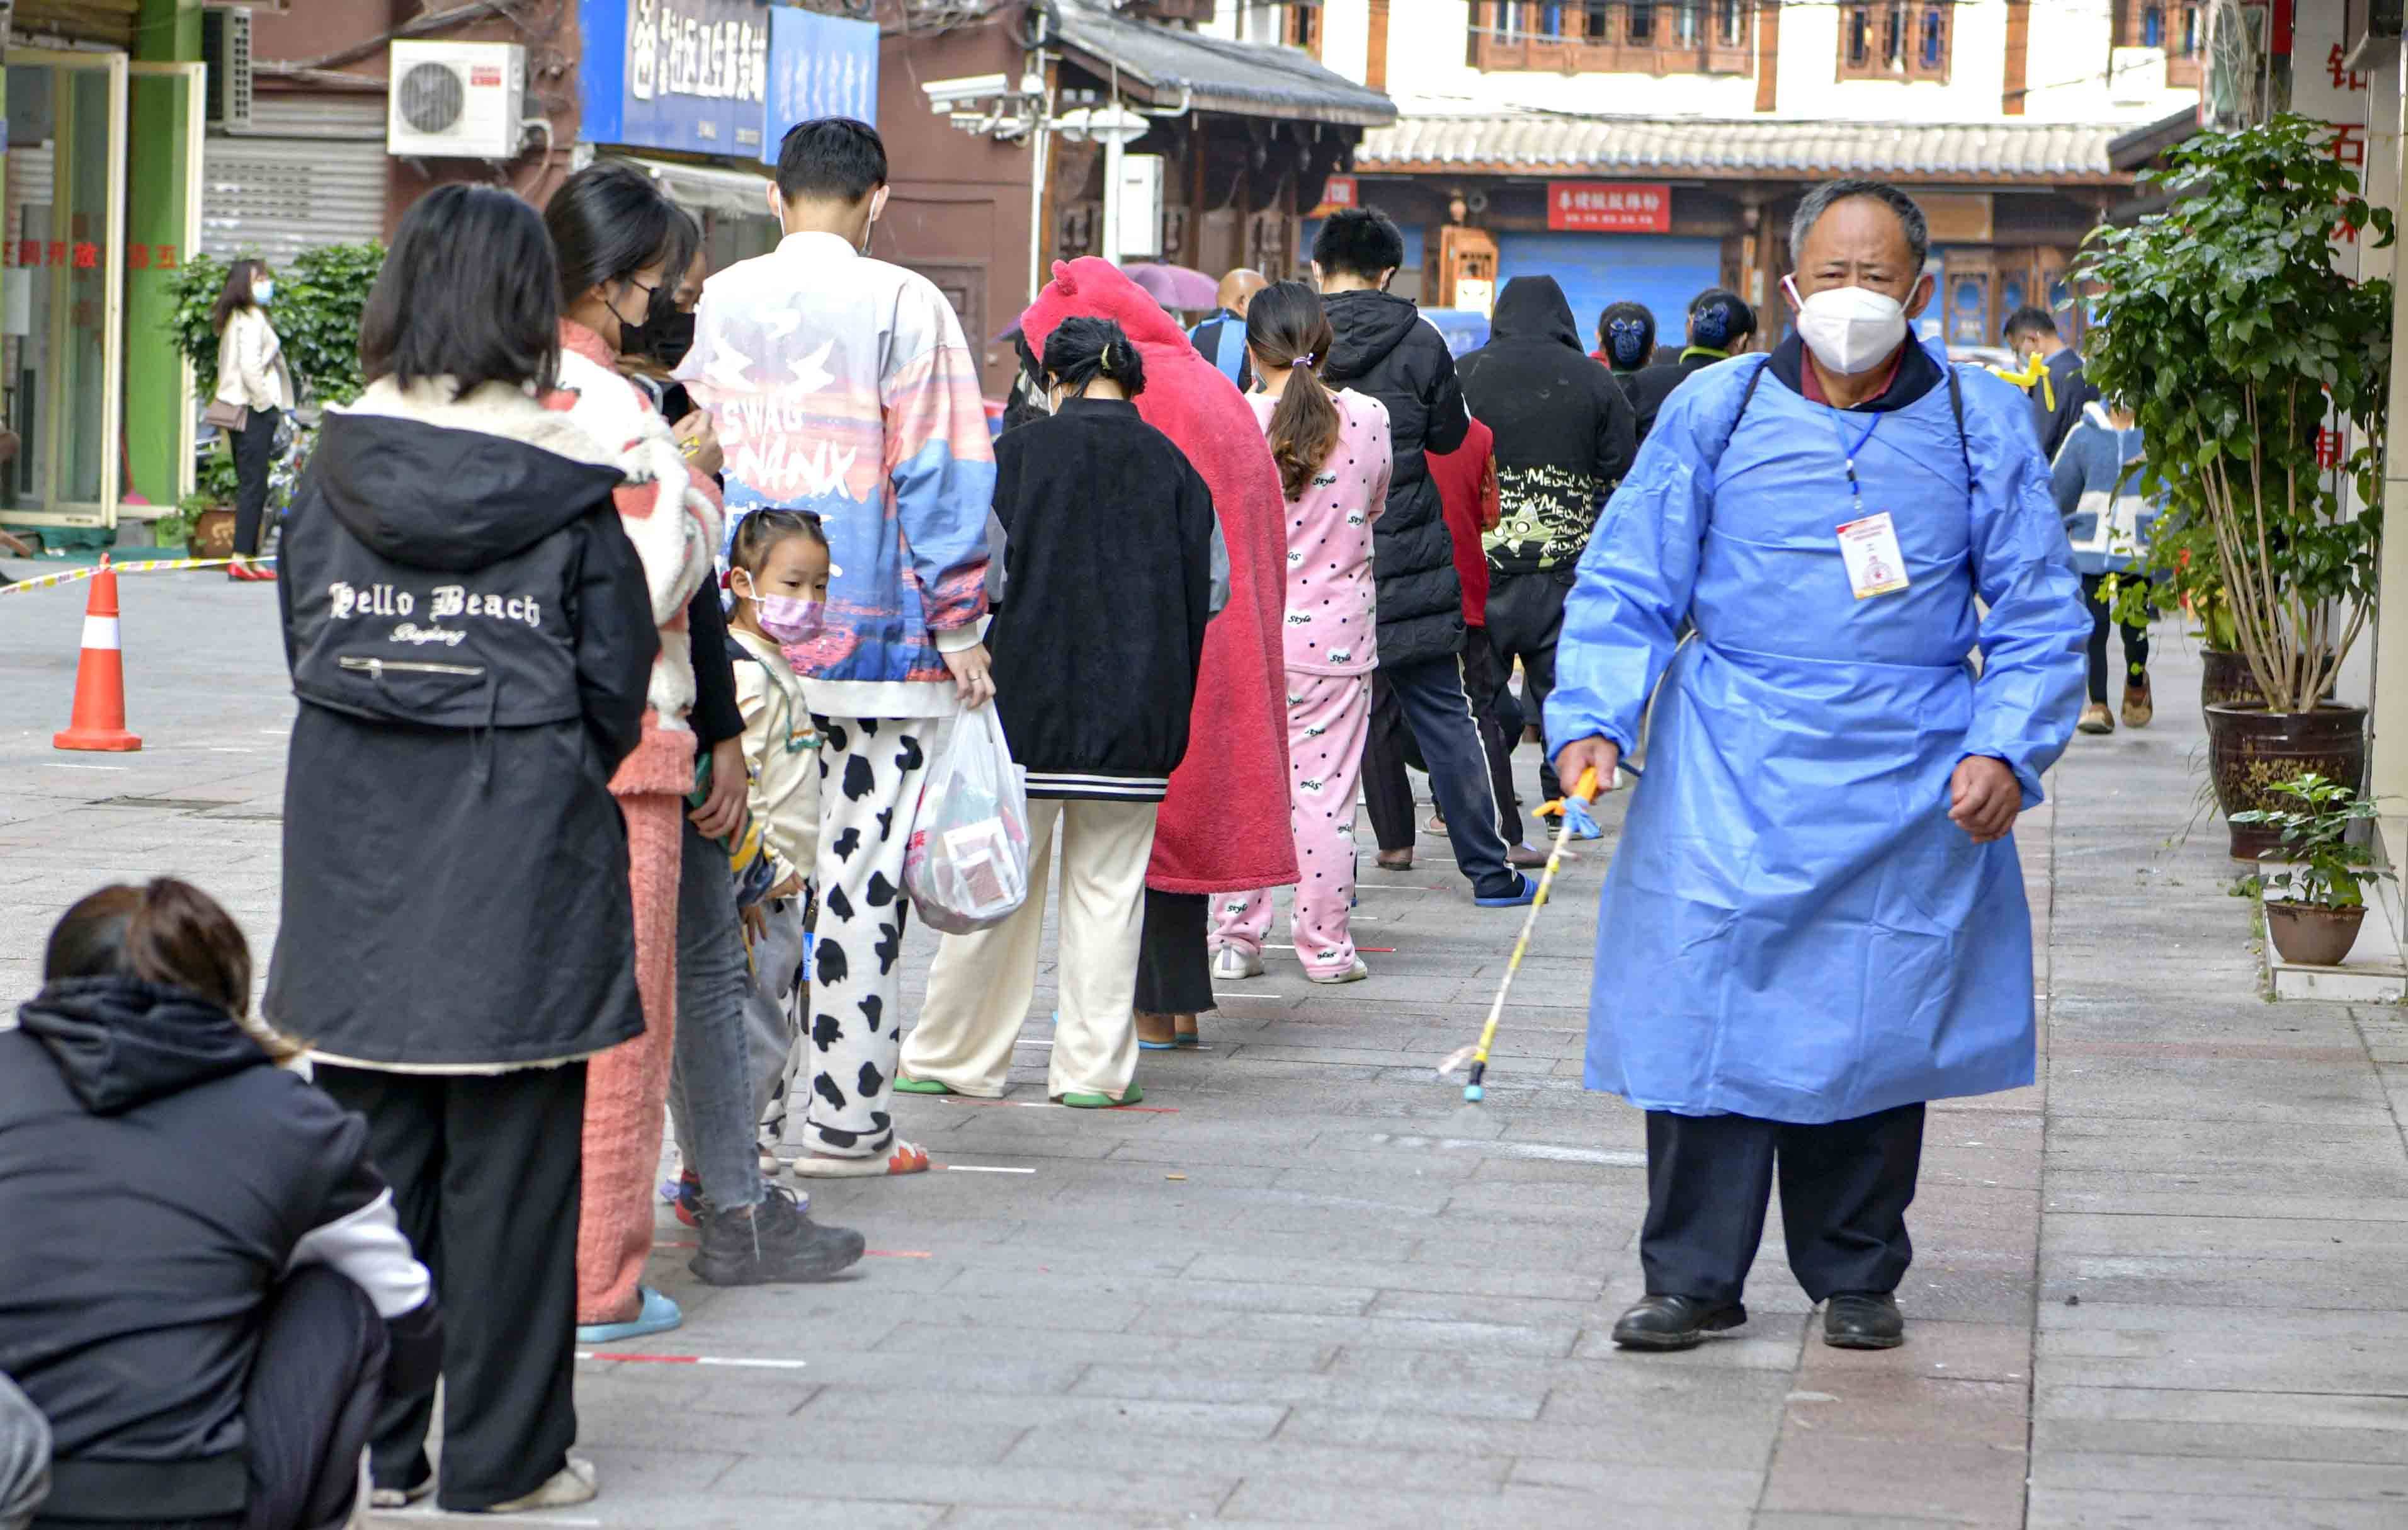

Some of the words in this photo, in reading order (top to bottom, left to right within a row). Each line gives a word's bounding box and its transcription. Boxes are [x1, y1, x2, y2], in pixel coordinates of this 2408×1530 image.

[718, 394, 804, 443] SWAG
[1348, 515, 1365, 526] Styl
[329, 581, 414, 619] Hello
[429, 585, 541, 627] Beach
[1288, 615, 1312, 625] Style
